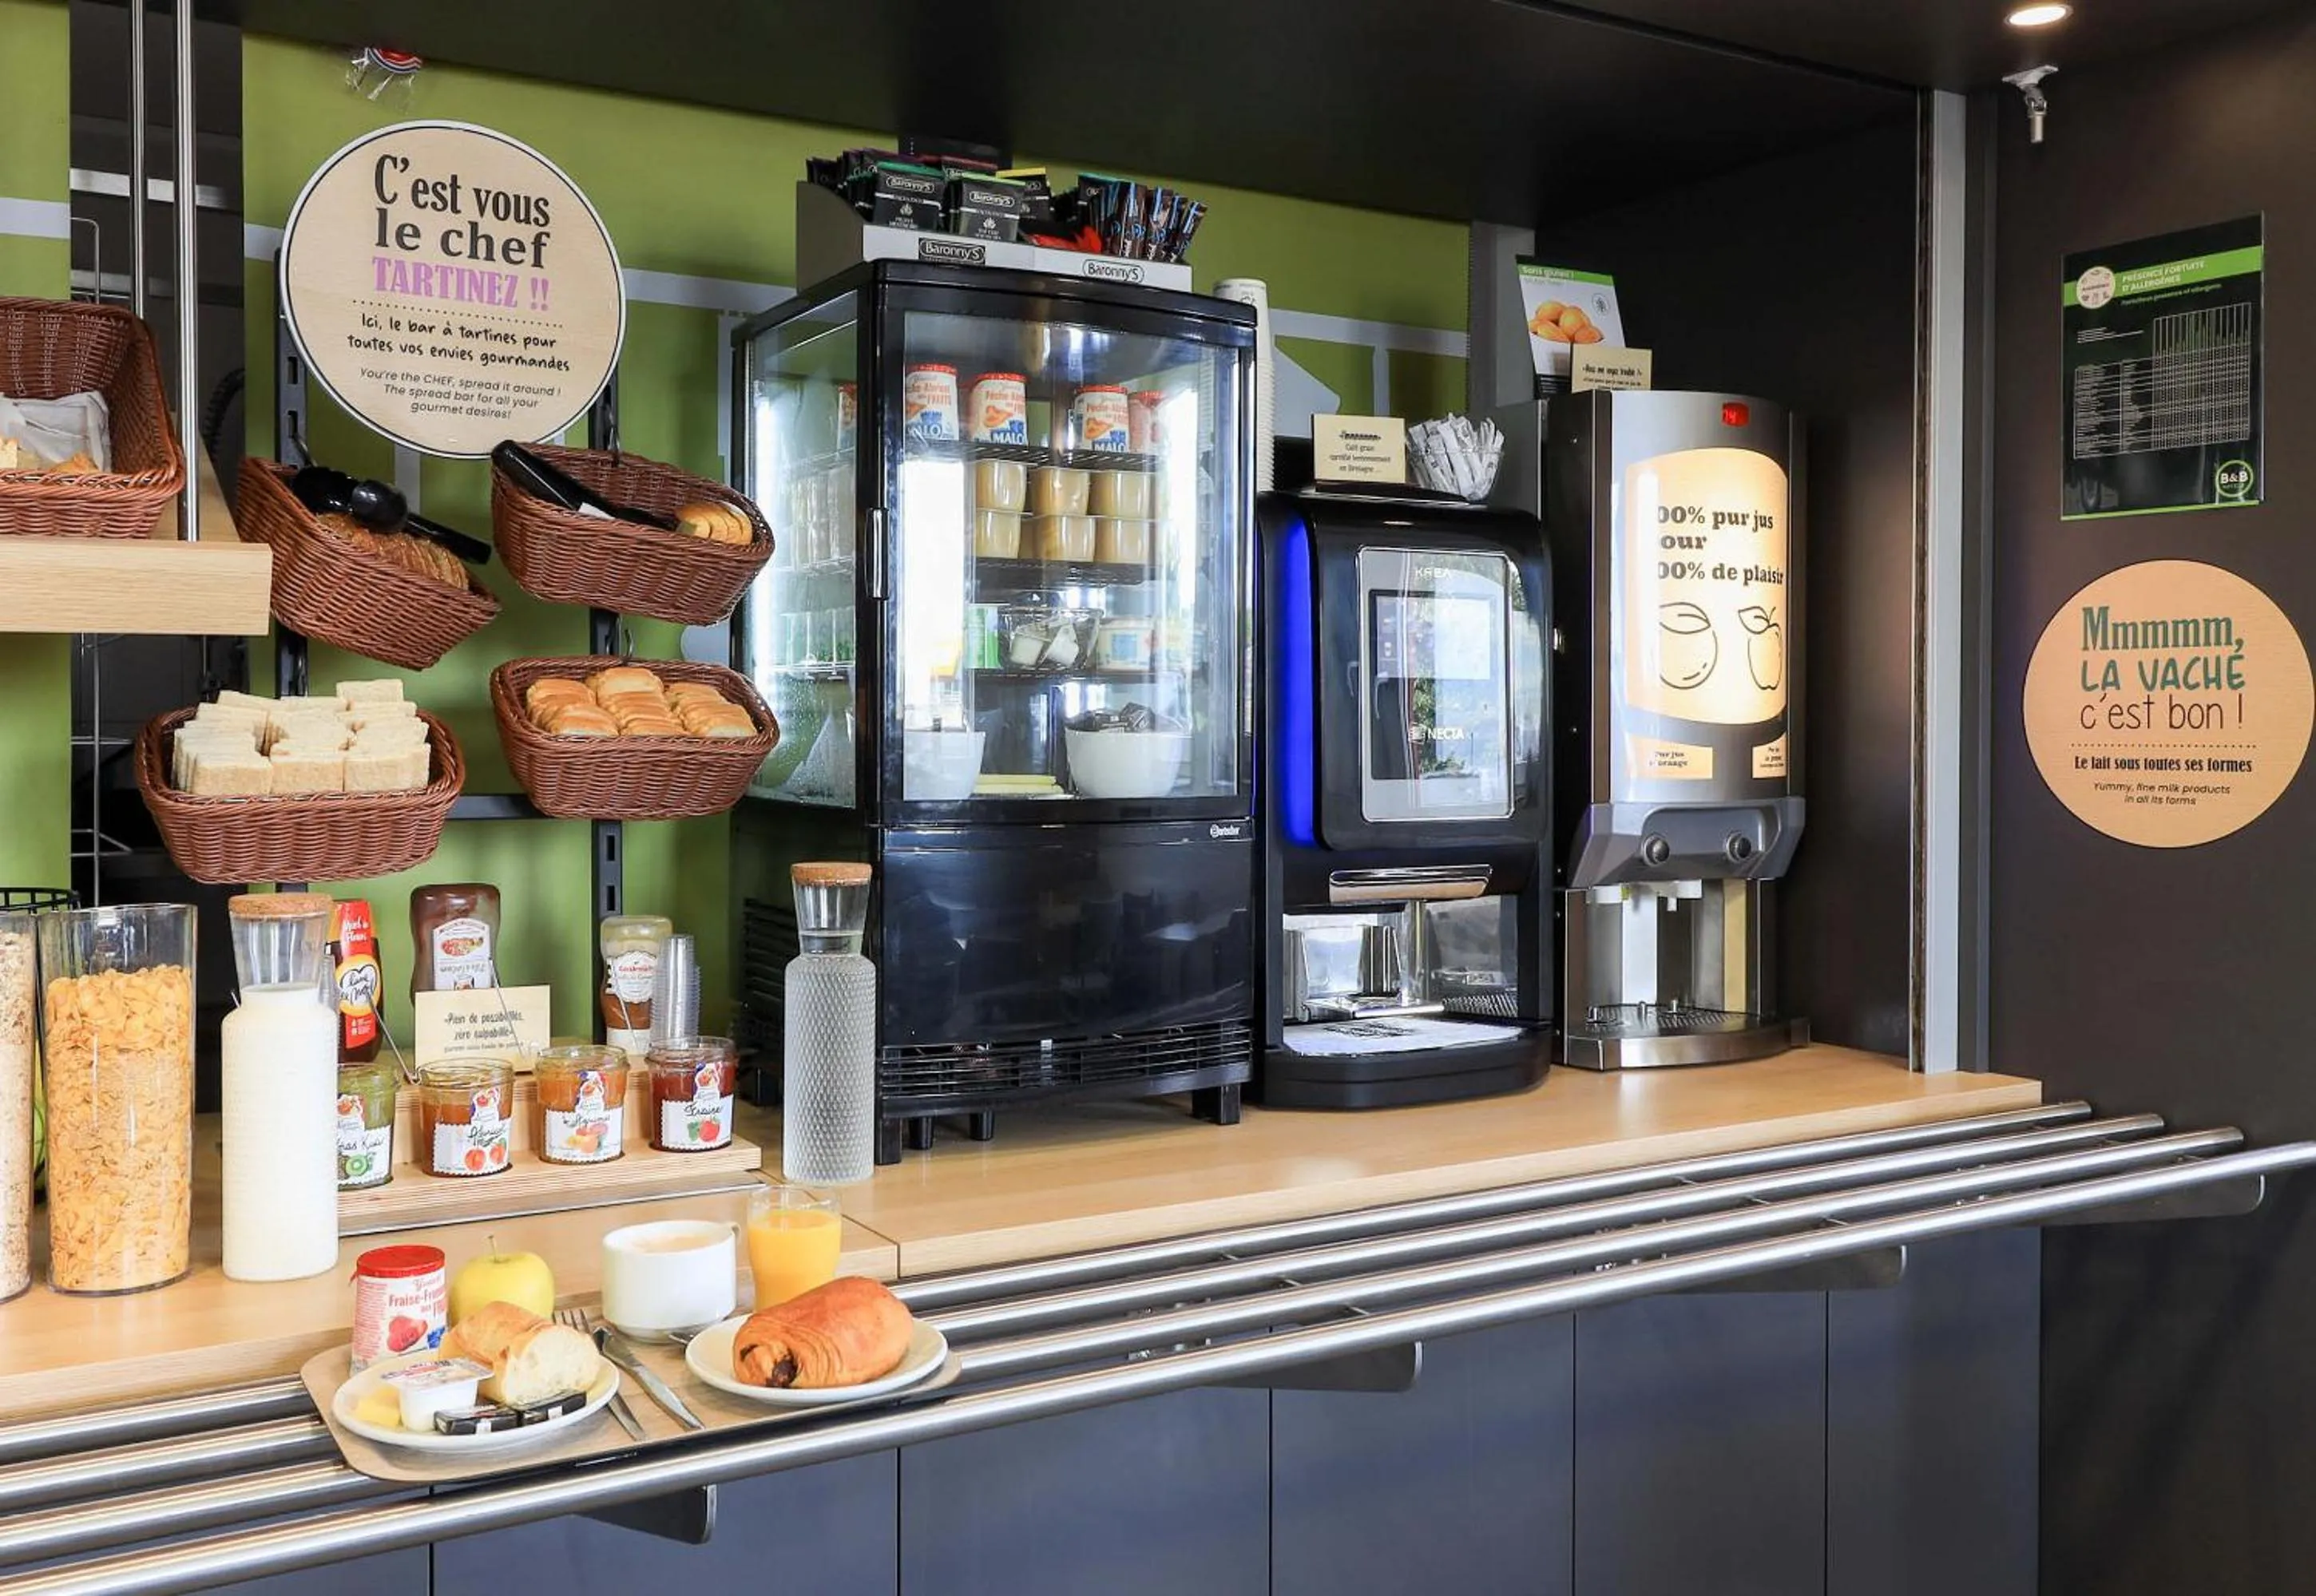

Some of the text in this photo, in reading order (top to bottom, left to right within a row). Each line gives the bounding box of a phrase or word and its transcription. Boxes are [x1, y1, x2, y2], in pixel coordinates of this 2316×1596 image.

[375, 154, 550, 228] C'est vous
[375, 208, 550, 268] le chef
[372, 256, 549, 311] TARTINEZ !!
[362, 313, 557, 350] Ici, le bar à tartines pour
[347, 335, 570, 372] toutes vos envies gourmandes
[360, 367, 398, 381] You're
[401, 371, 421, 382] the
[459, 379, 500, 391] spread
[502, 382, 510, 391] it
[513, 385, 555, 396] around
[383, 383, 539, 408] The spread bar for all your
[410, 402, 463, 414] gourmet
[2220, 470, 2248, 484] B&B
[1657, 505, 1774, 533] 00% pur jus
[1660, 534, 1707, 549] our
[1657, 561, 1784, 586] 00% de plaisir
[2081, 606, 2245, 653] Mmmmm,
[2081, 654, 2246, 691] LA VACHE
[2080, 692, 2243, 730] c'est bon !
[2074, 755, 2253, 773] Le lait sous toutes ses formes
[2124, 794, 2197, 806] in all its forms
[2136, 782, 2156, 793] fine
[2158, 782, 2179, 793] milk
[2181, 785, 2231, 795] products
